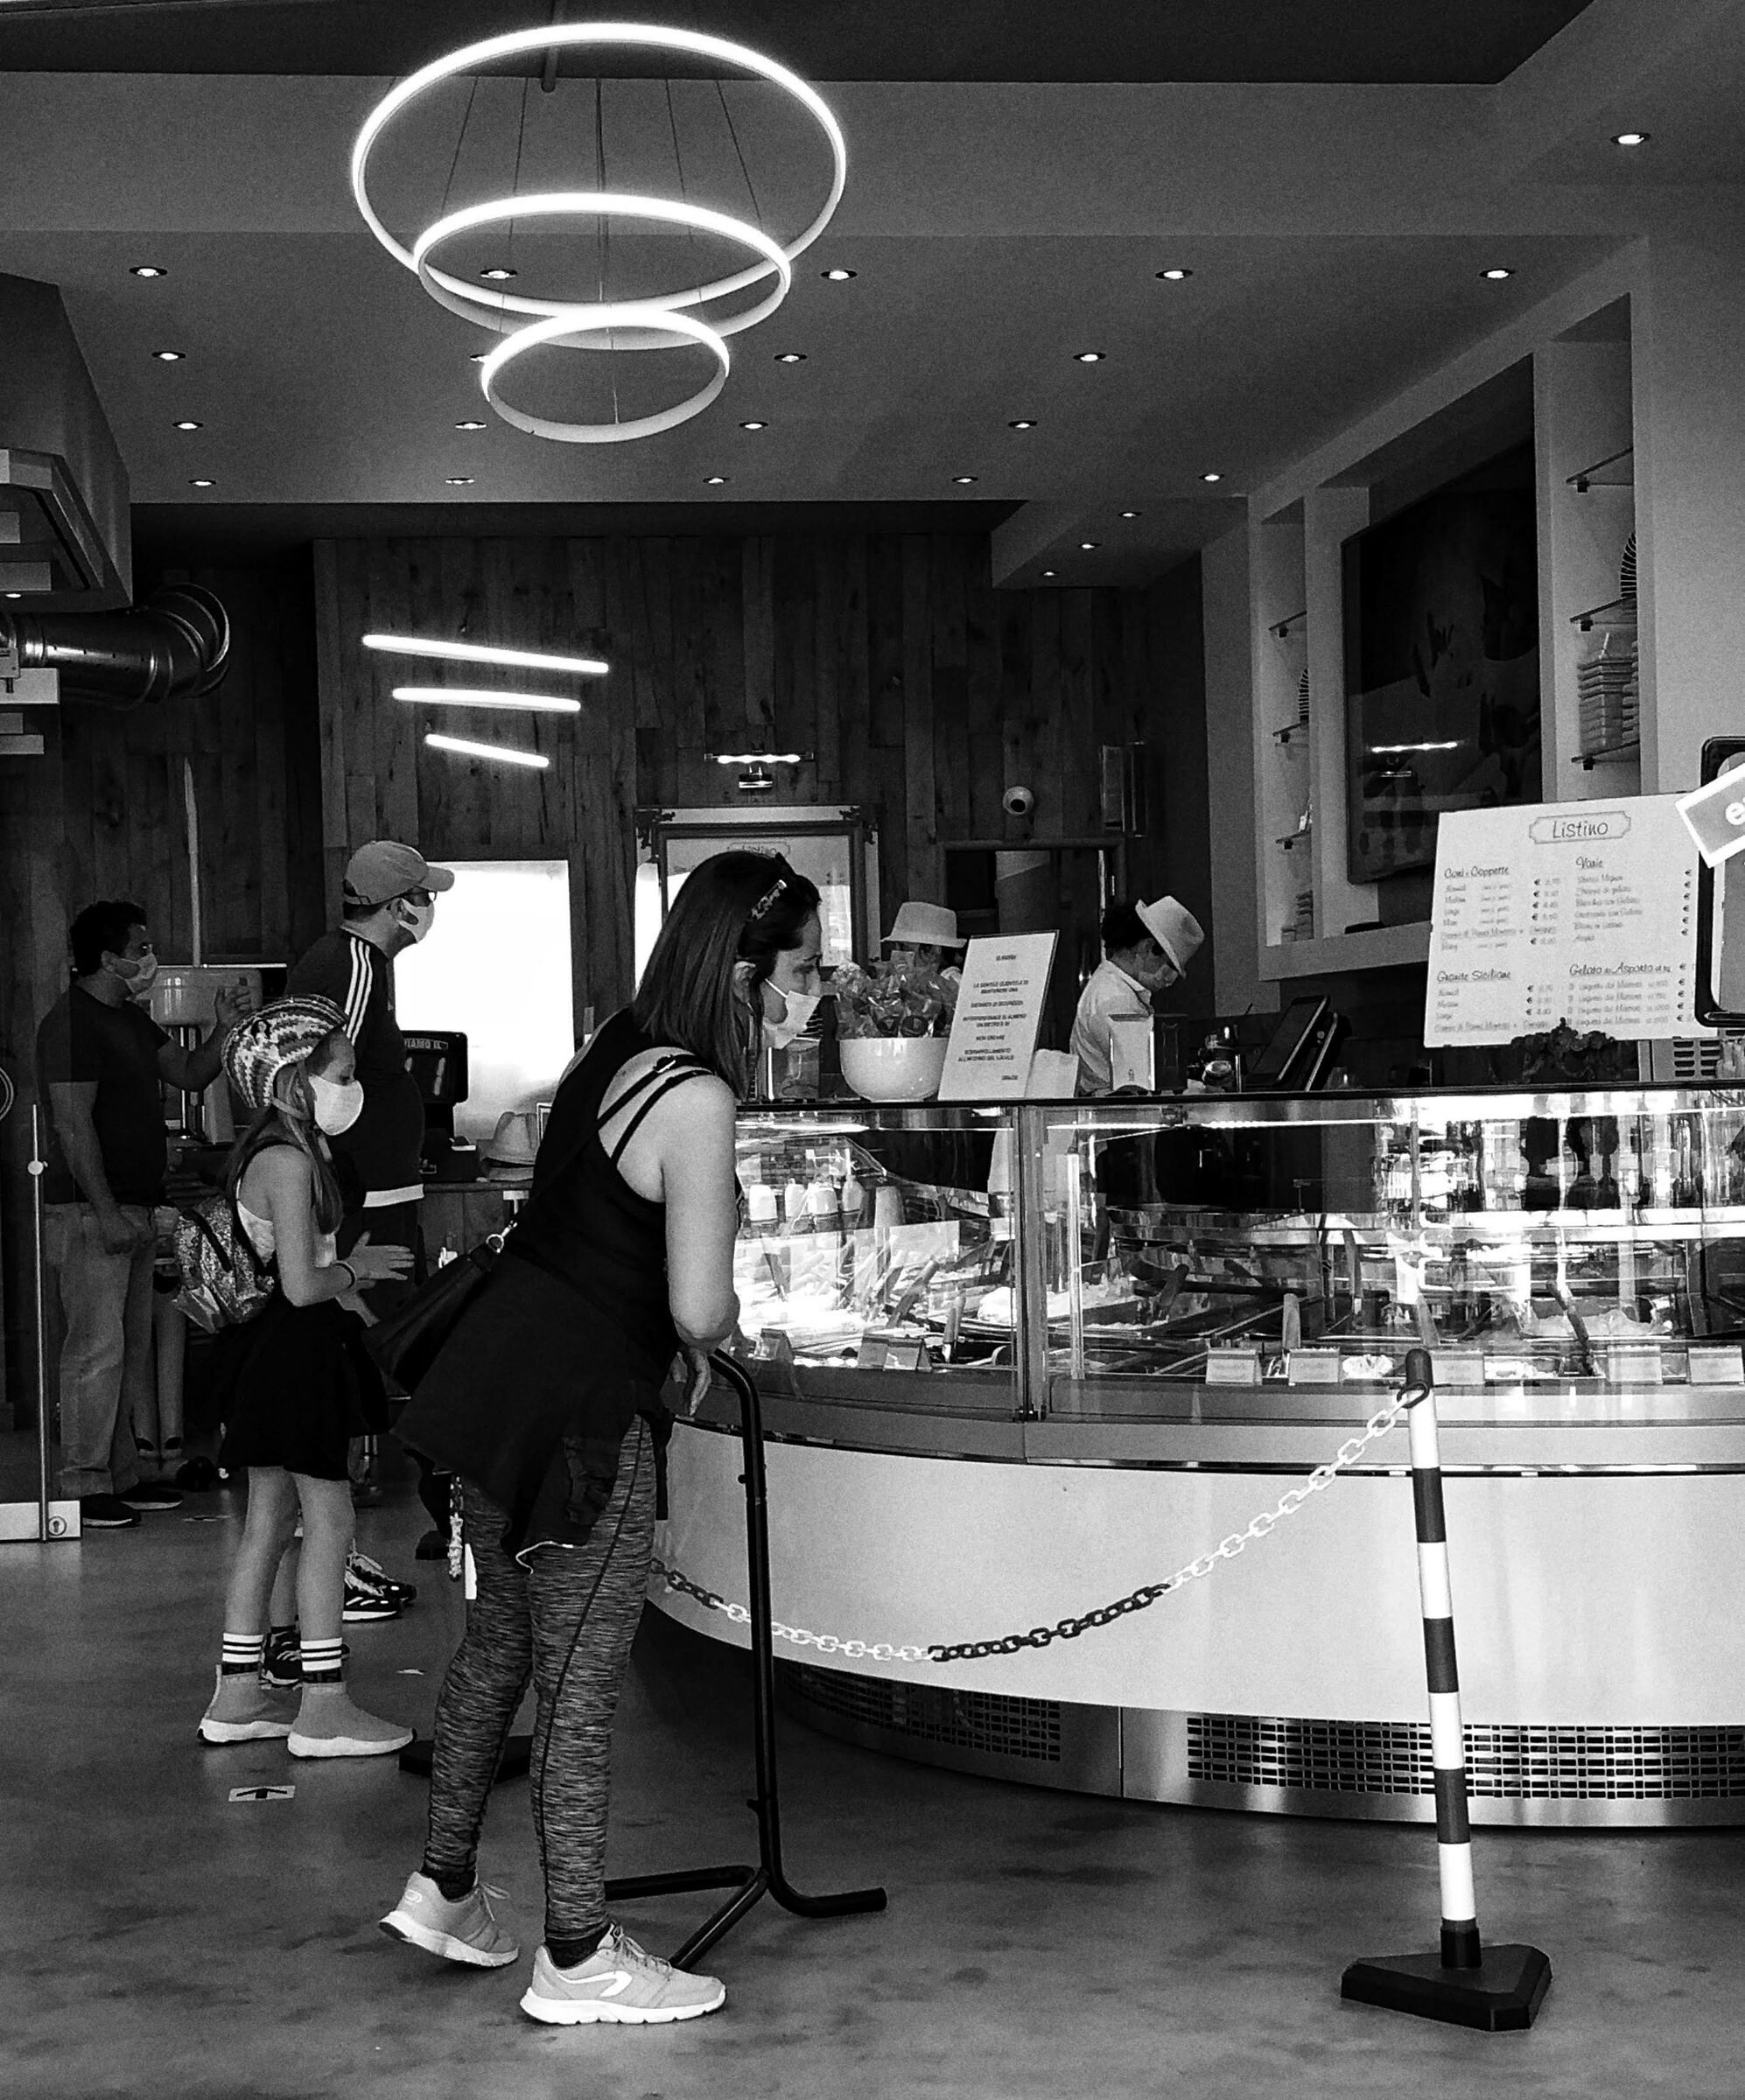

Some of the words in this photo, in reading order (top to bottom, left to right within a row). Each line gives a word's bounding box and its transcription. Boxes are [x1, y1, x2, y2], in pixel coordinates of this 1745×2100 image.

[1552, 821, 1608, 838] Listino
[1470, 866, 1510, 877] Coppette
[1472, 968, 1510, 980] Siciliane
[1570, 963, 1601, 976] Gelato
[1612, 962, 1654, 975] Asporto
